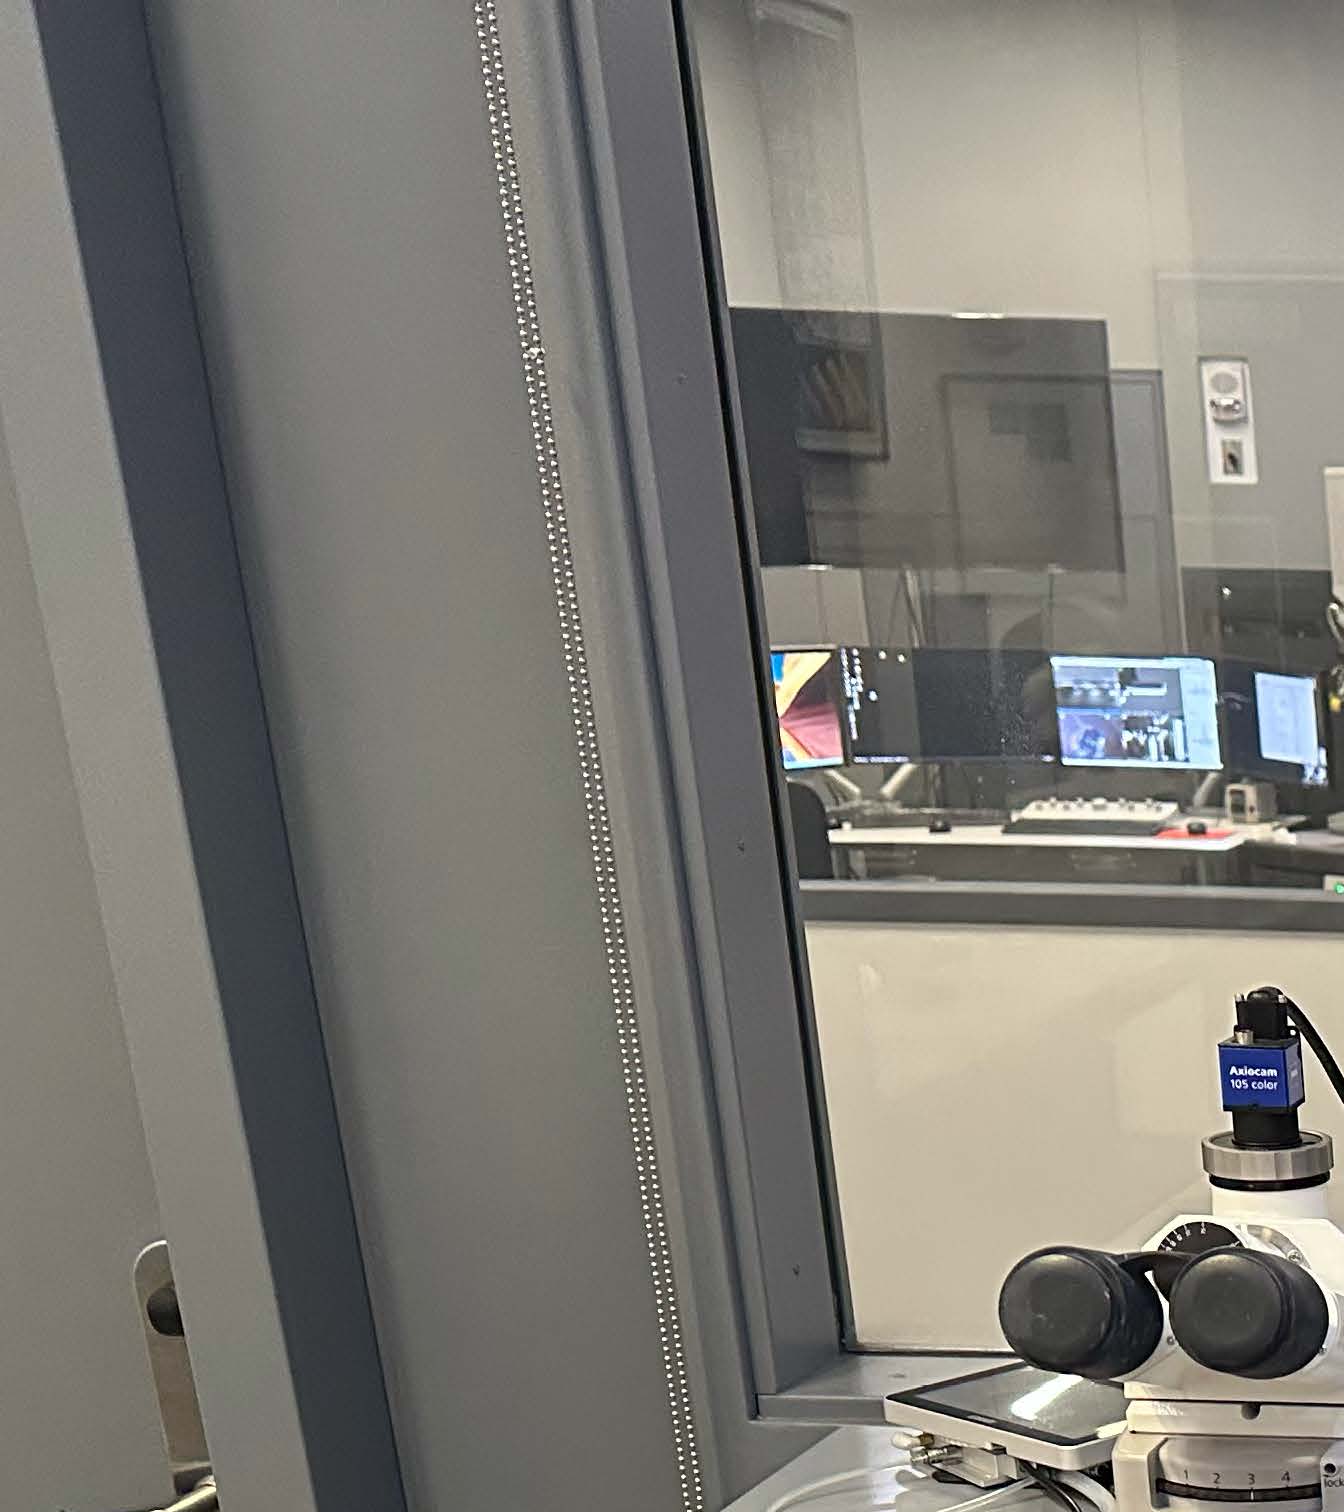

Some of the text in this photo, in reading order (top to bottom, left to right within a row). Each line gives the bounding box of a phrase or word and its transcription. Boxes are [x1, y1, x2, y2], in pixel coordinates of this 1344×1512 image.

[1229, 1065, 1278, 1077] Axiocam
[1230, 1079, 1279, 1090] 105 color
[1183, 1468, 1291, 1485] 1 2 3 4
[1323, 1476, 1344, 1488] lock
